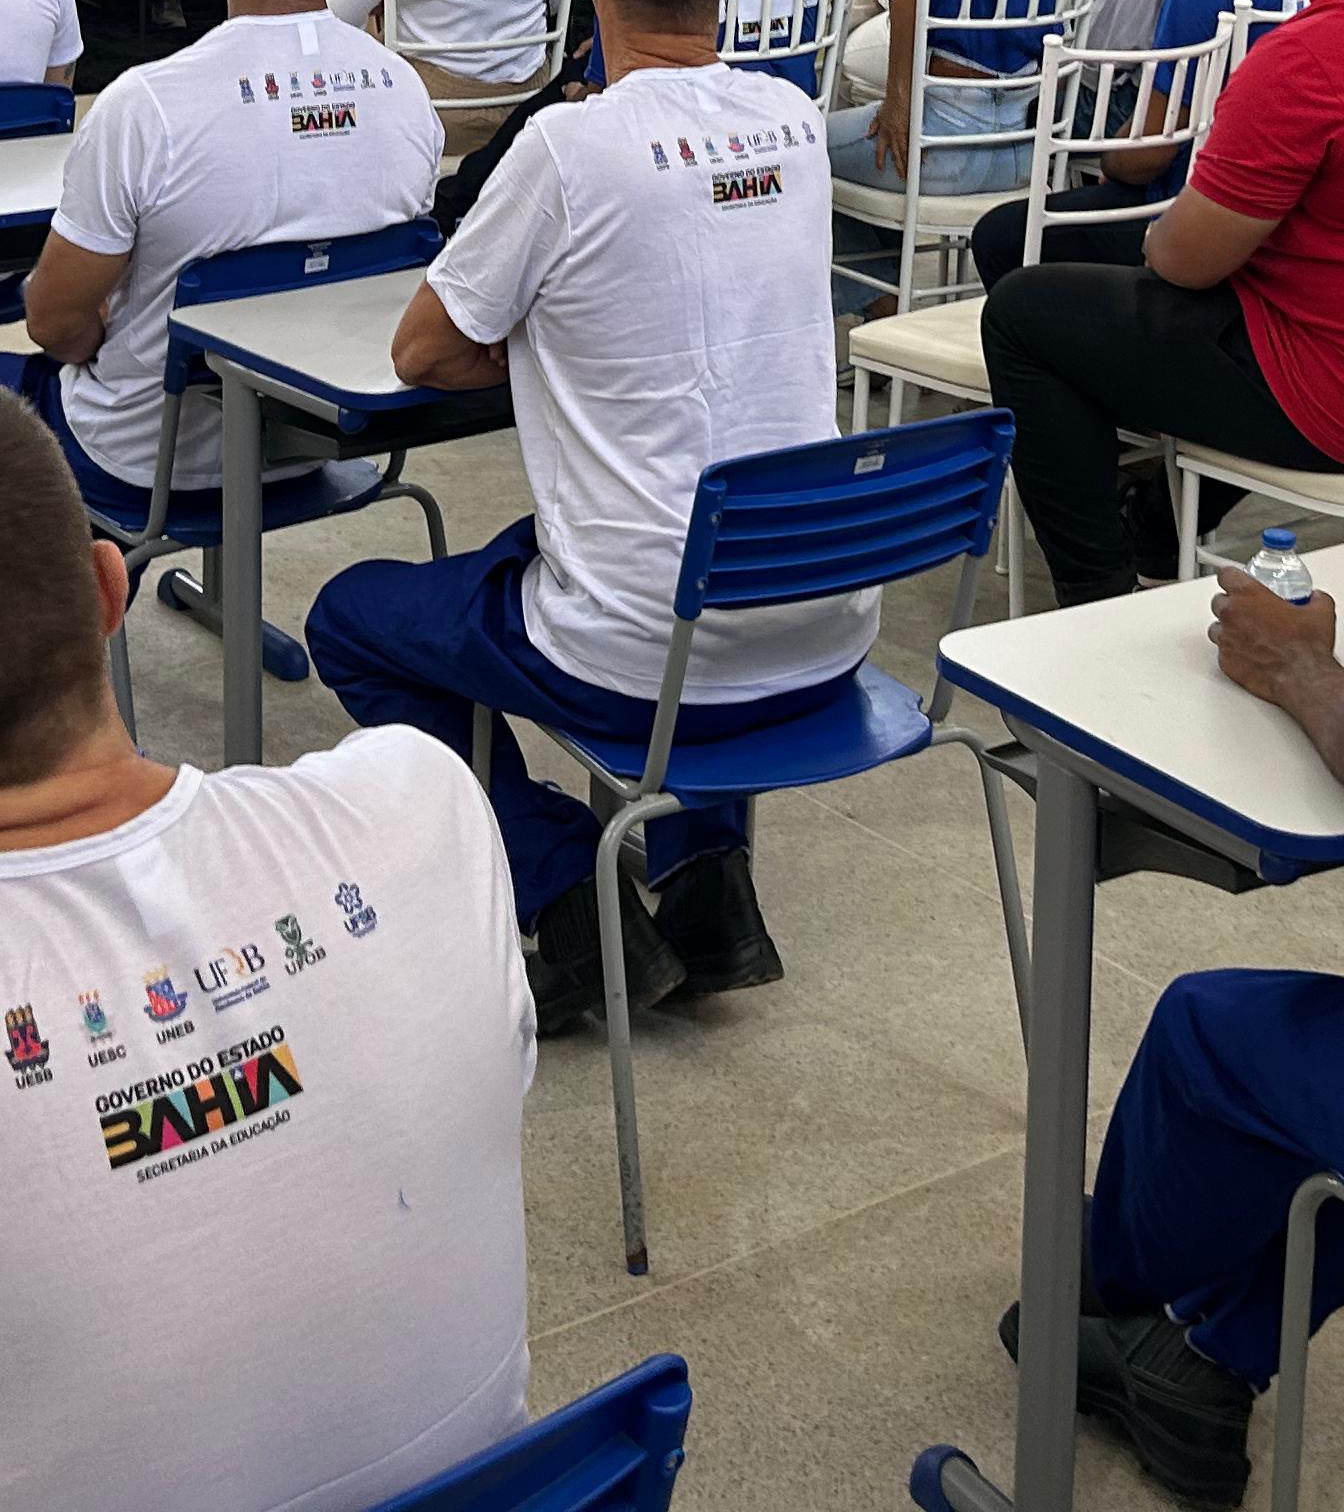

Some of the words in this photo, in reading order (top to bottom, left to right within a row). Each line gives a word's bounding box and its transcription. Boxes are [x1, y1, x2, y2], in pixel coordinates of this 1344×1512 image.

[291, 110, 357, 133] BAHIA
[713, 172, 783, 203] BAHIA
[283, 945, 327, 977] UFOB
[155, 1020, 196, 1045] UNEB
[87, 1045, 127, 1068] UESC
[95, 1064, 185, 1115] GOVERNO
[187, 1050, 215, 1079] DO
[218, 1025, 286, 1067] ESTADO
[15, 1069, 53, 1090] UESB
[99, 1041, 304, 1170] BAHIA
[136, 1145, 210, 1183] SECRETARIA
[211, 1134, 229, 1154] DA
[230, 1109, 292, 1146] EDUCAÇÃO
